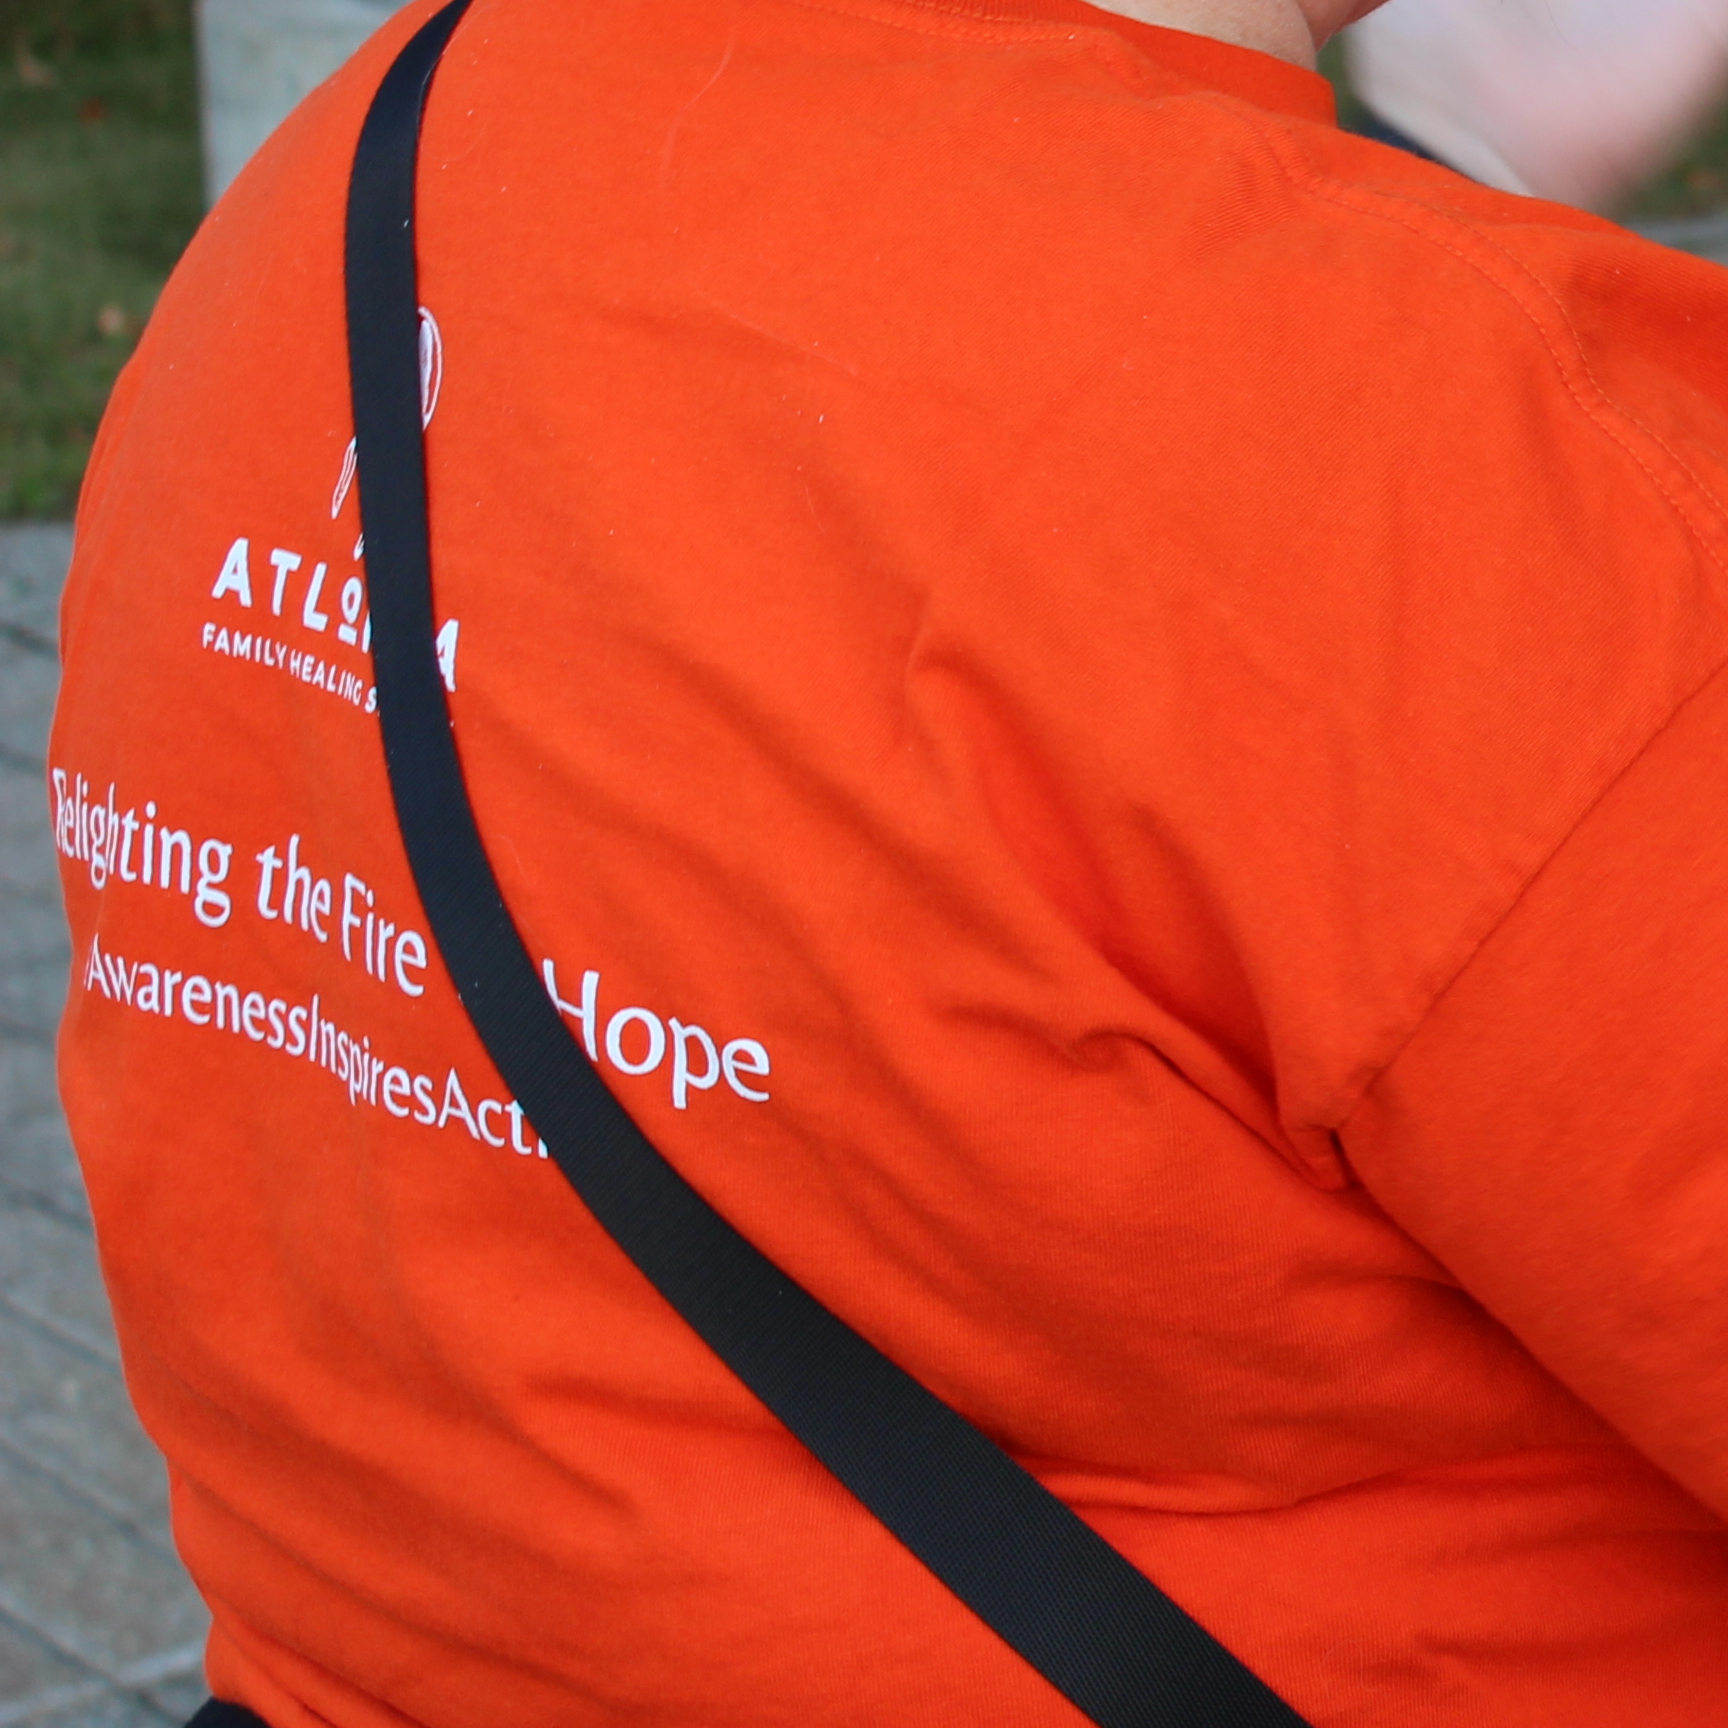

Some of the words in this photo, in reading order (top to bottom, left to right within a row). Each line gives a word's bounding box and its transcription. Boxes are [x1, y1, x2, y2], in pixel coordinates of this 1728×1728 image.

[202, 622, 287, 670] FAMILY
[289, 648, 363, 706] HEALING
[210, 536, 459, 693] ATLOA
[52, 767, 233, 928] Relighting
[256, 833, 332, 943] the
[341, 872, 427, 996] Fire
[542, 958, 771, 1110] Hope
